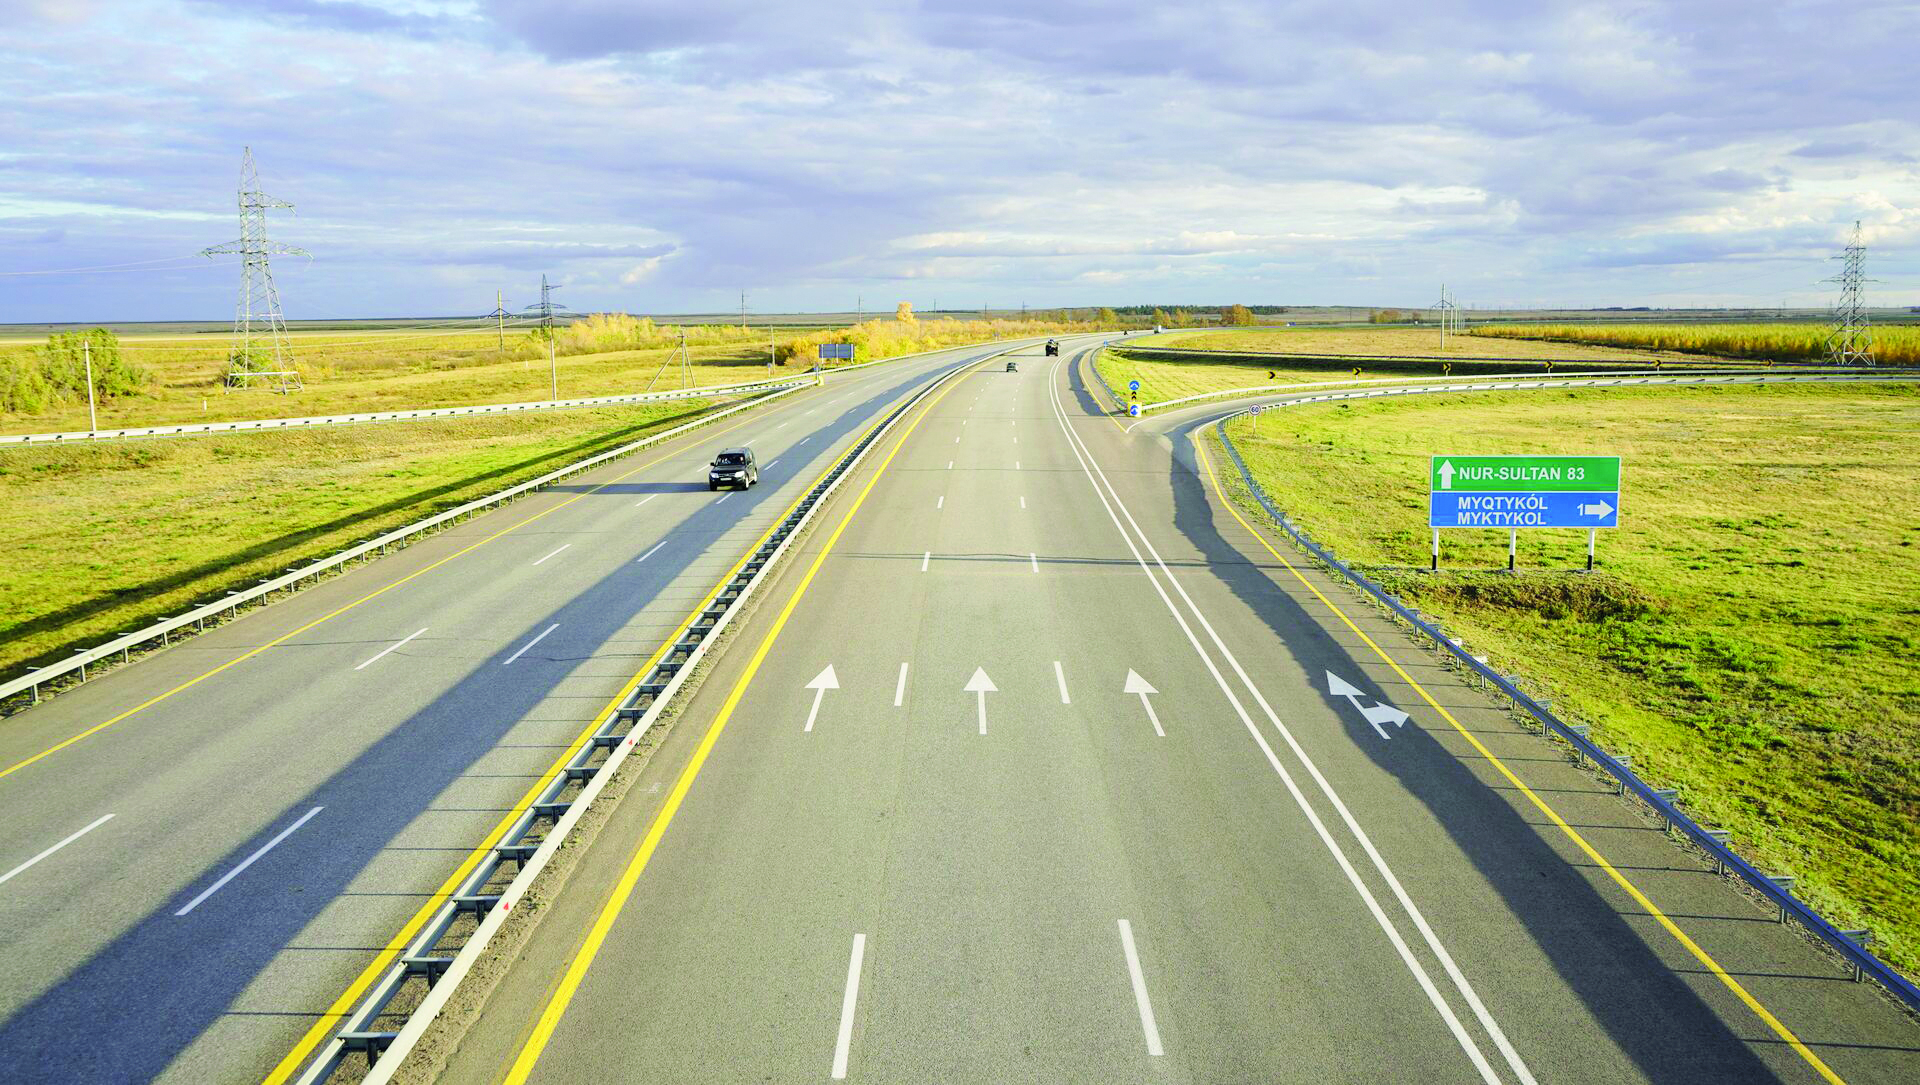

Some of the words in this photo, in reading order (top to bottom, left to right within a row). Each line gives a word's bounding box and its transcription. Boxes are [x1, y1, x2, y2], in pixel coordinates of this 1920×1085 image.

[1459, 467, 1561, 480] NUR-SULTAN
[1567, 467, 1585, 480] 83
[1458, 494, 1548, 510] MYQTYKÓL
[1577, 503, 1584, 516] 1
[1457, 512, 1547, 525] MYKTYKOL
